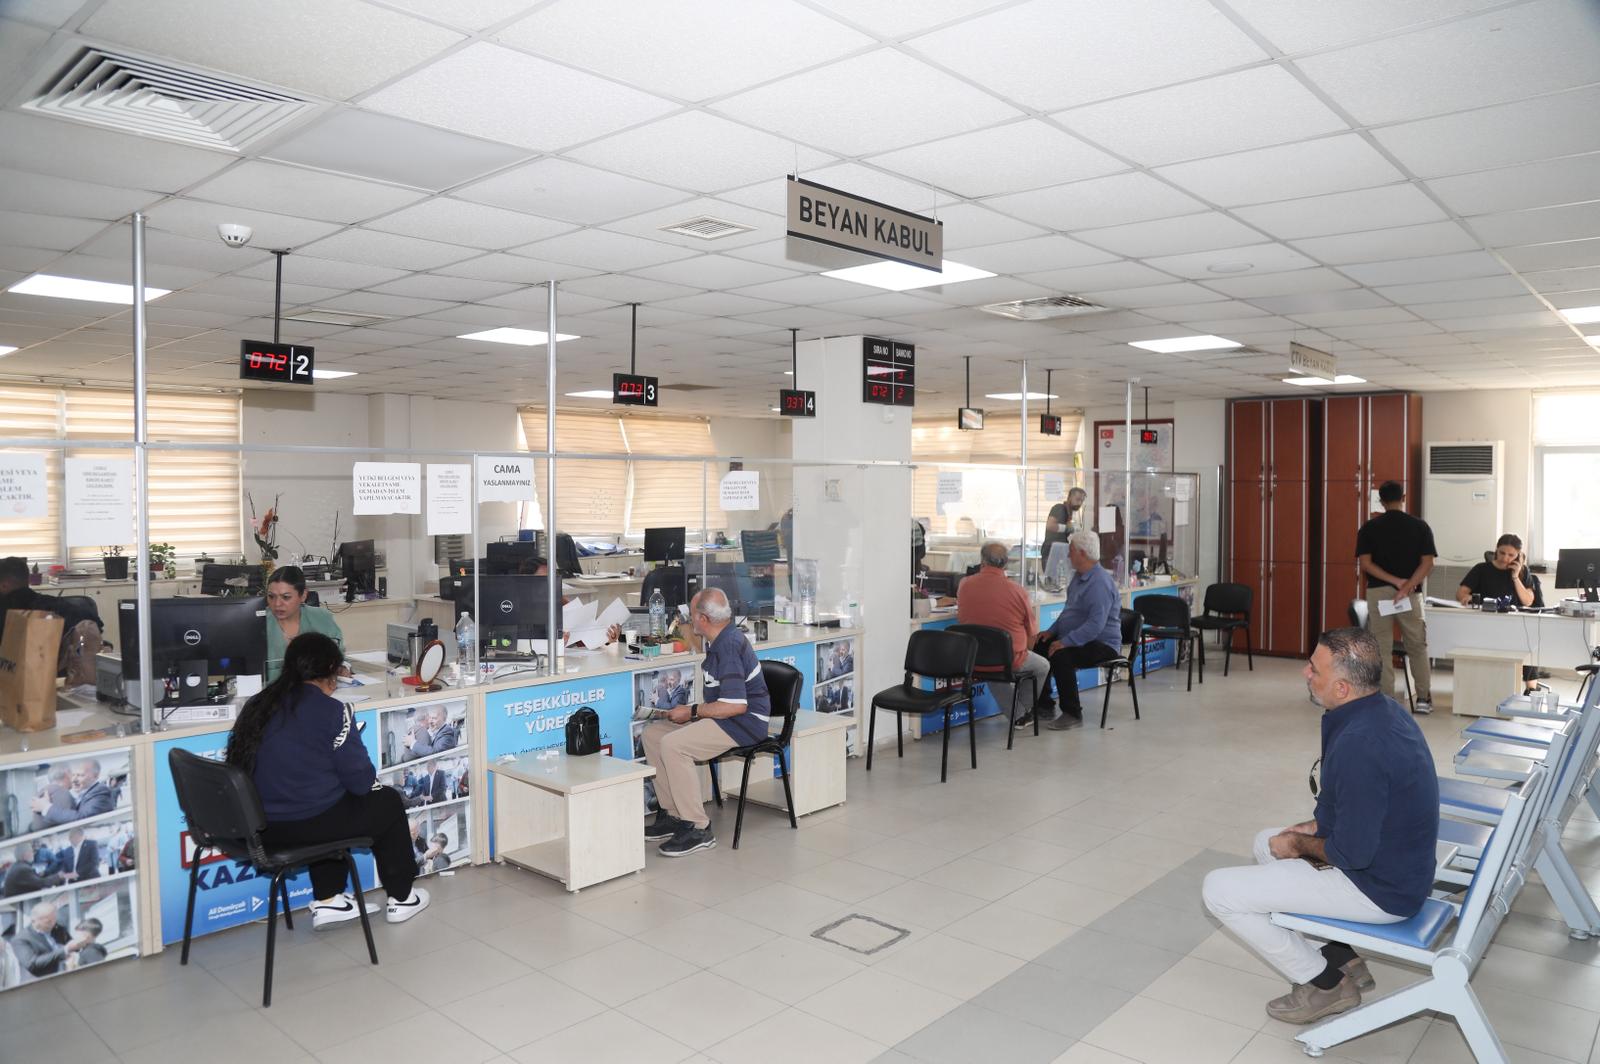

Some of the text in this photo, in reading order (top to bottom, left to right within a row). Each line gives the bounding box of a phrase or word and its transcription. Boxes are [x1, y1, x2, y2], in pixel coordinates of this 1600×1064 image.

[799, 195, 934, 256] BEYAN KABUL
[250, 351, 287, 371] 072
[295, 355, 309, 375] 2
[647, 384, 654, 400] 3
[807, 397, 813, 411] 4
[494, 464, 521, 474] CAMA
[483, 479, 531, 487] YASLANMAYINIZ
[504, 688, 605, 717] TEŞEKKÜRLER
